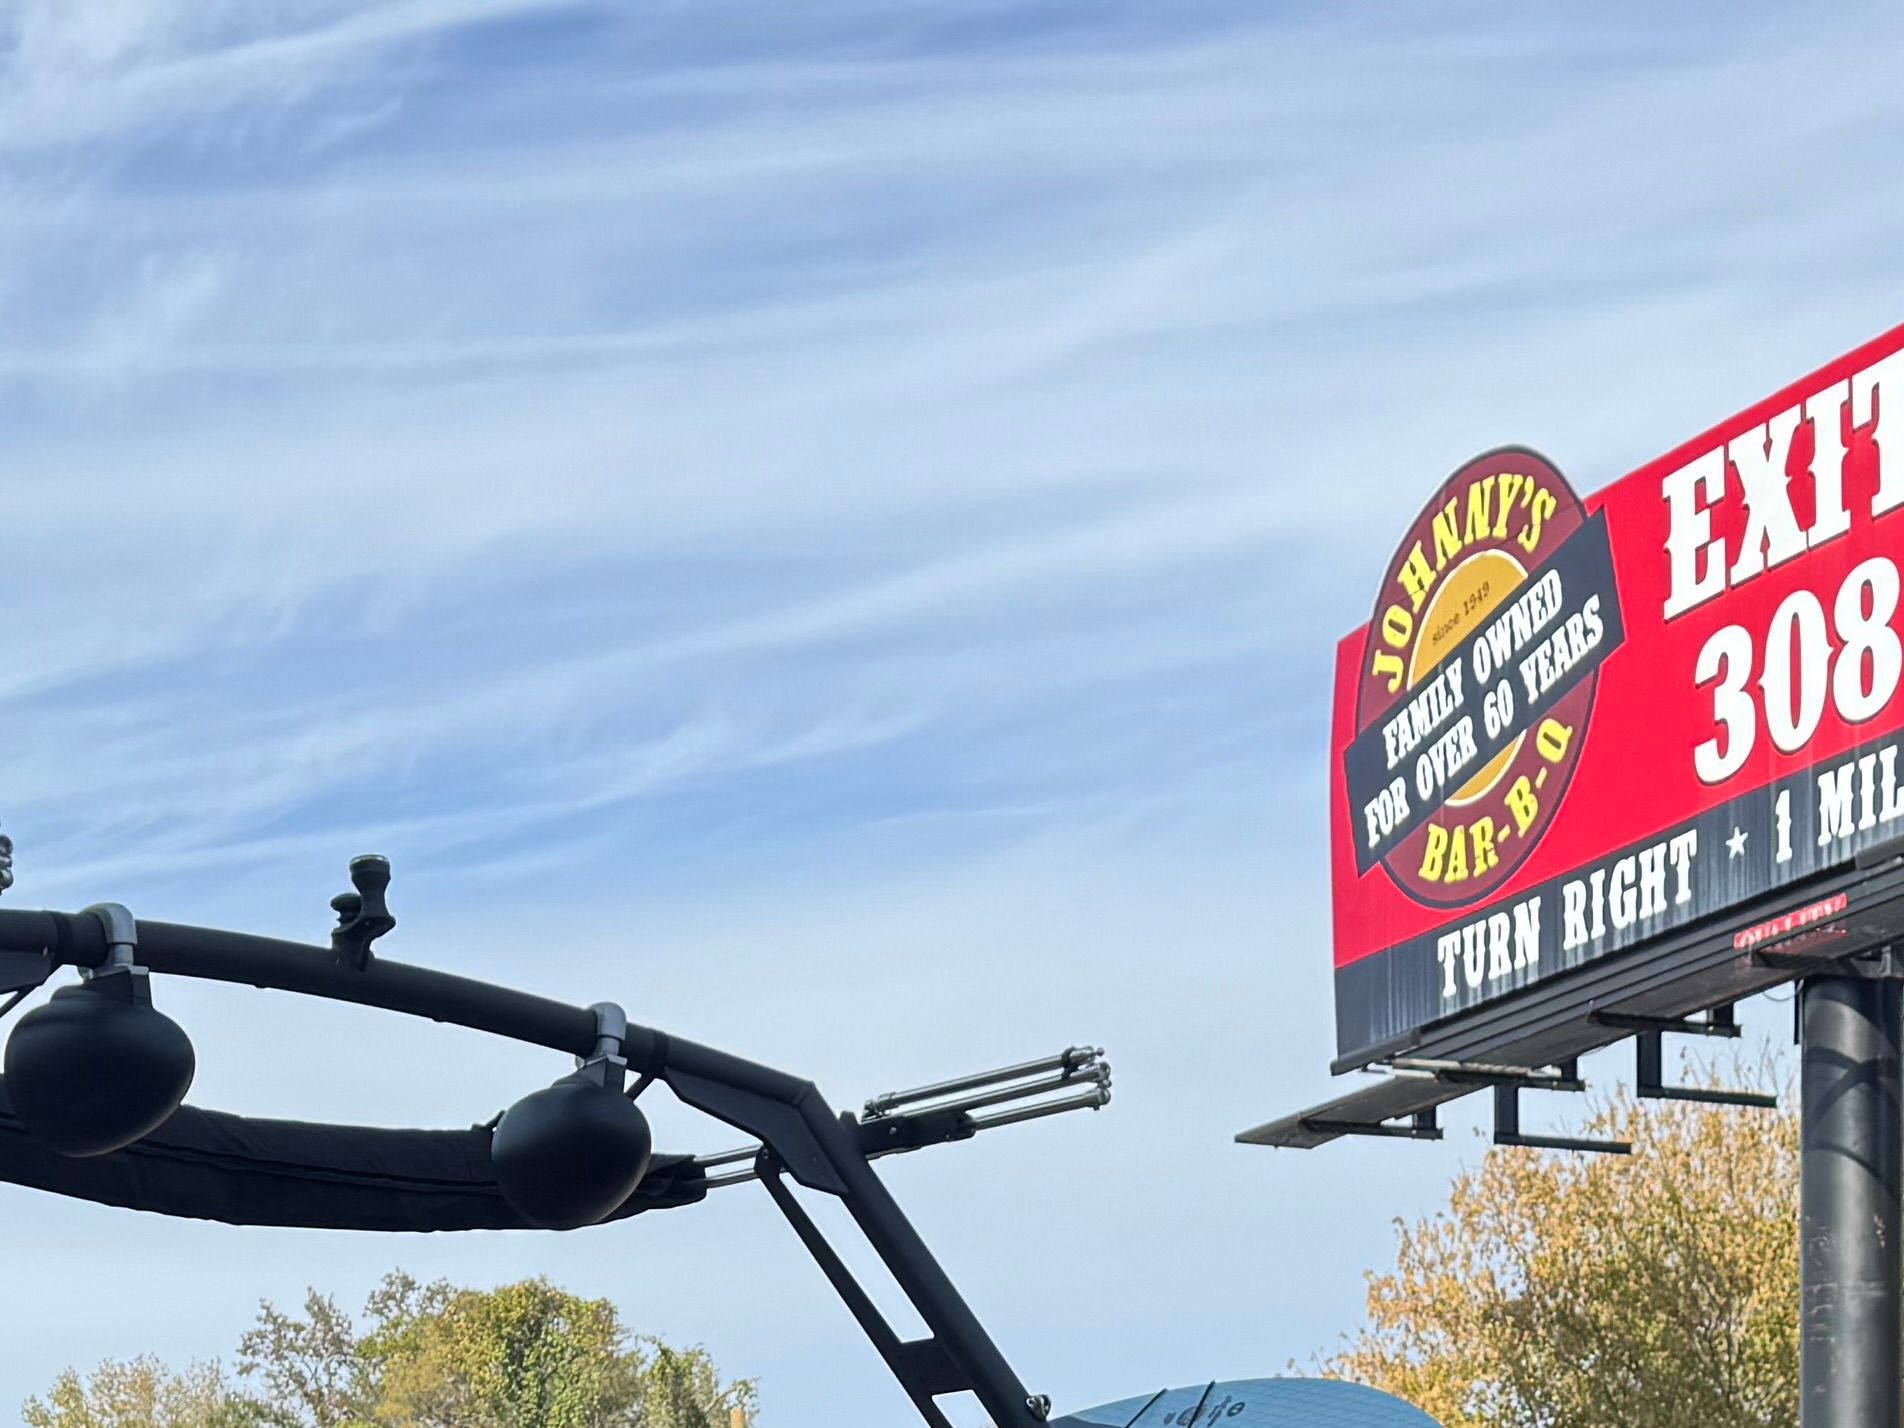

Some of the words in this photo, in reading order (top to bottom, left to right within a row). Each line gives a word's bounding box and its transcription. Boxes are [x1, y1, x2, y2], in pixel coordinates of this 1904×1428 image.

[1372, 473, 1556, 694] JOHNNY'S
[1382, 658, 1464, 770] FAMILY
[1472, 568, 1562, 684] OWNED
[1432, 613, 1460, 645] since
[1463, 581, 1490, 616] 1949
[1694, 556, 1904, 785] 308
[1363, 776, 1410, 848] FOR
[1416, 715, 1478, 801] OVER
[1484, 679, 1514, 740] 60
[1519, 594, 1604, 704] YEARS
[1418, 717, 1573, 883] BAR-B-Q
[1437, 896, 1541, 998] TURN
[1563, 829, 1697, 950] RIGHT
[1775, 789, 1792, 863] 1
